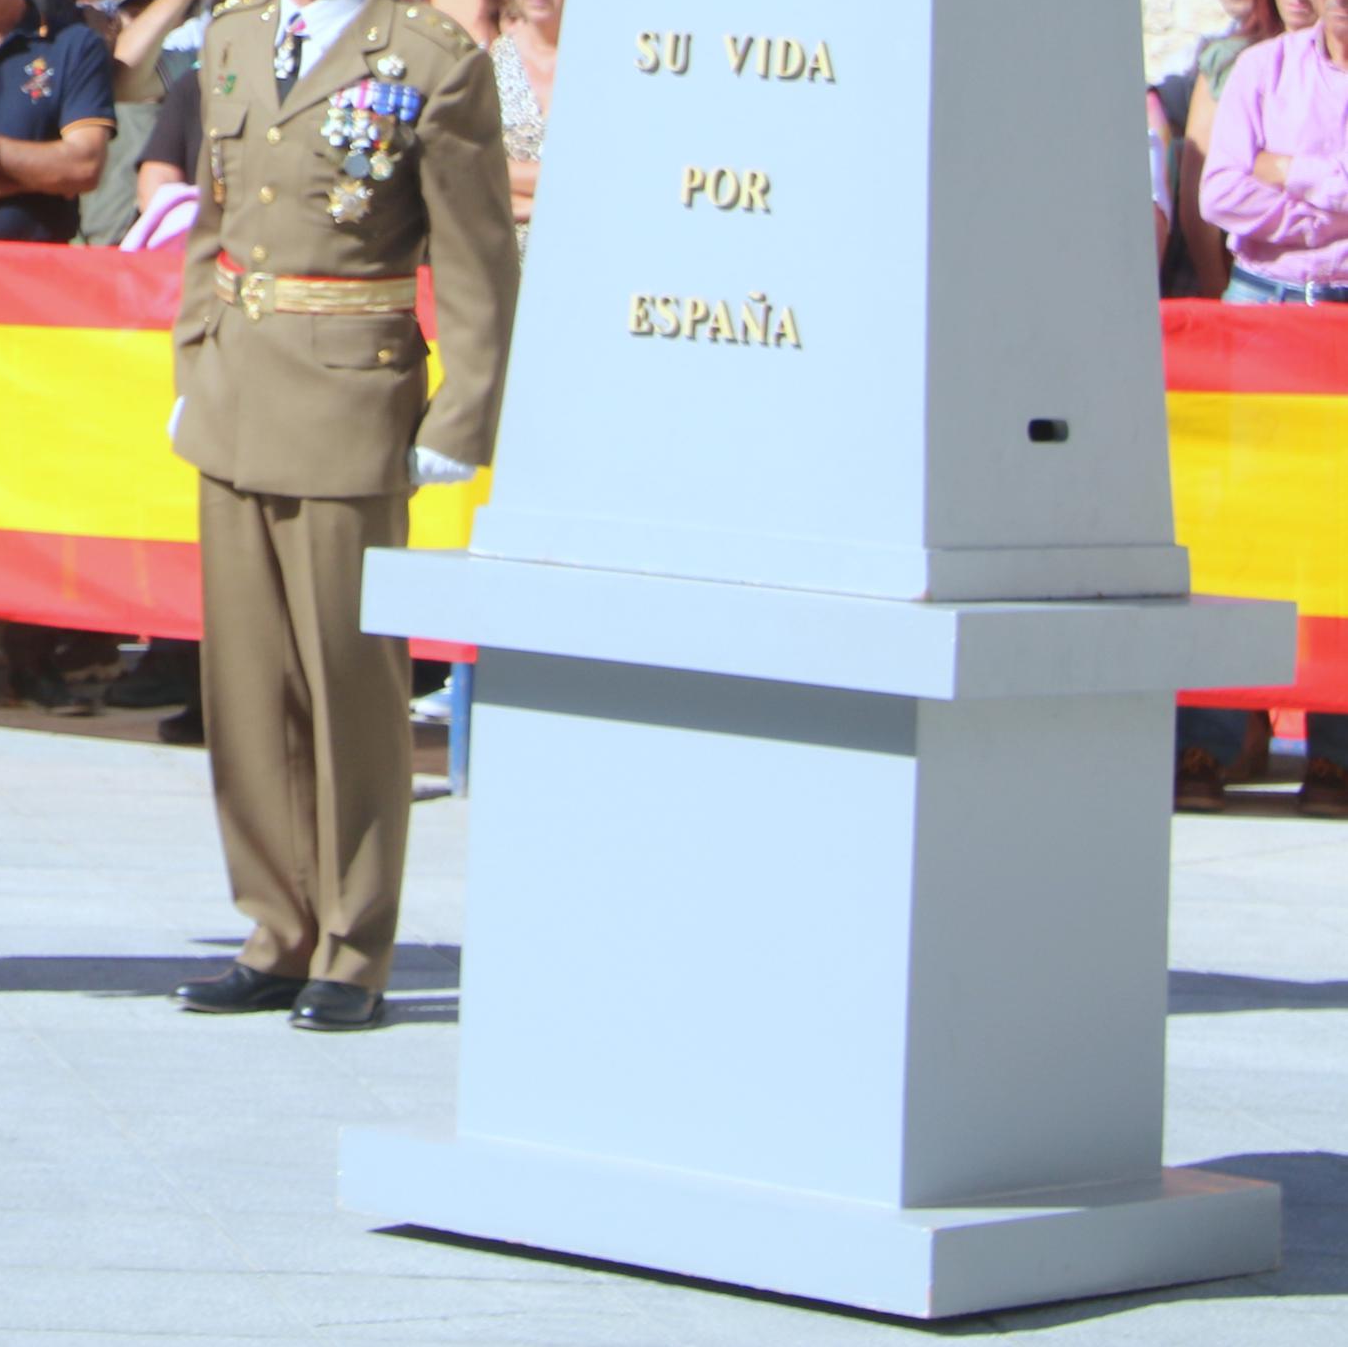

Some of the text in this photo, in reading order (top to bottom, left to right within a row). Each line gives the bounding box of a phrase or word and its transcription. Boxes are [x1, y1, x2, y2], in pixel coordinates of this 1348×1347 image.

[634, 30, 836, 85] SU VIDA
[680, 165, 772, 215] POR
[629, 291, 802, 350] ESPAÑA
